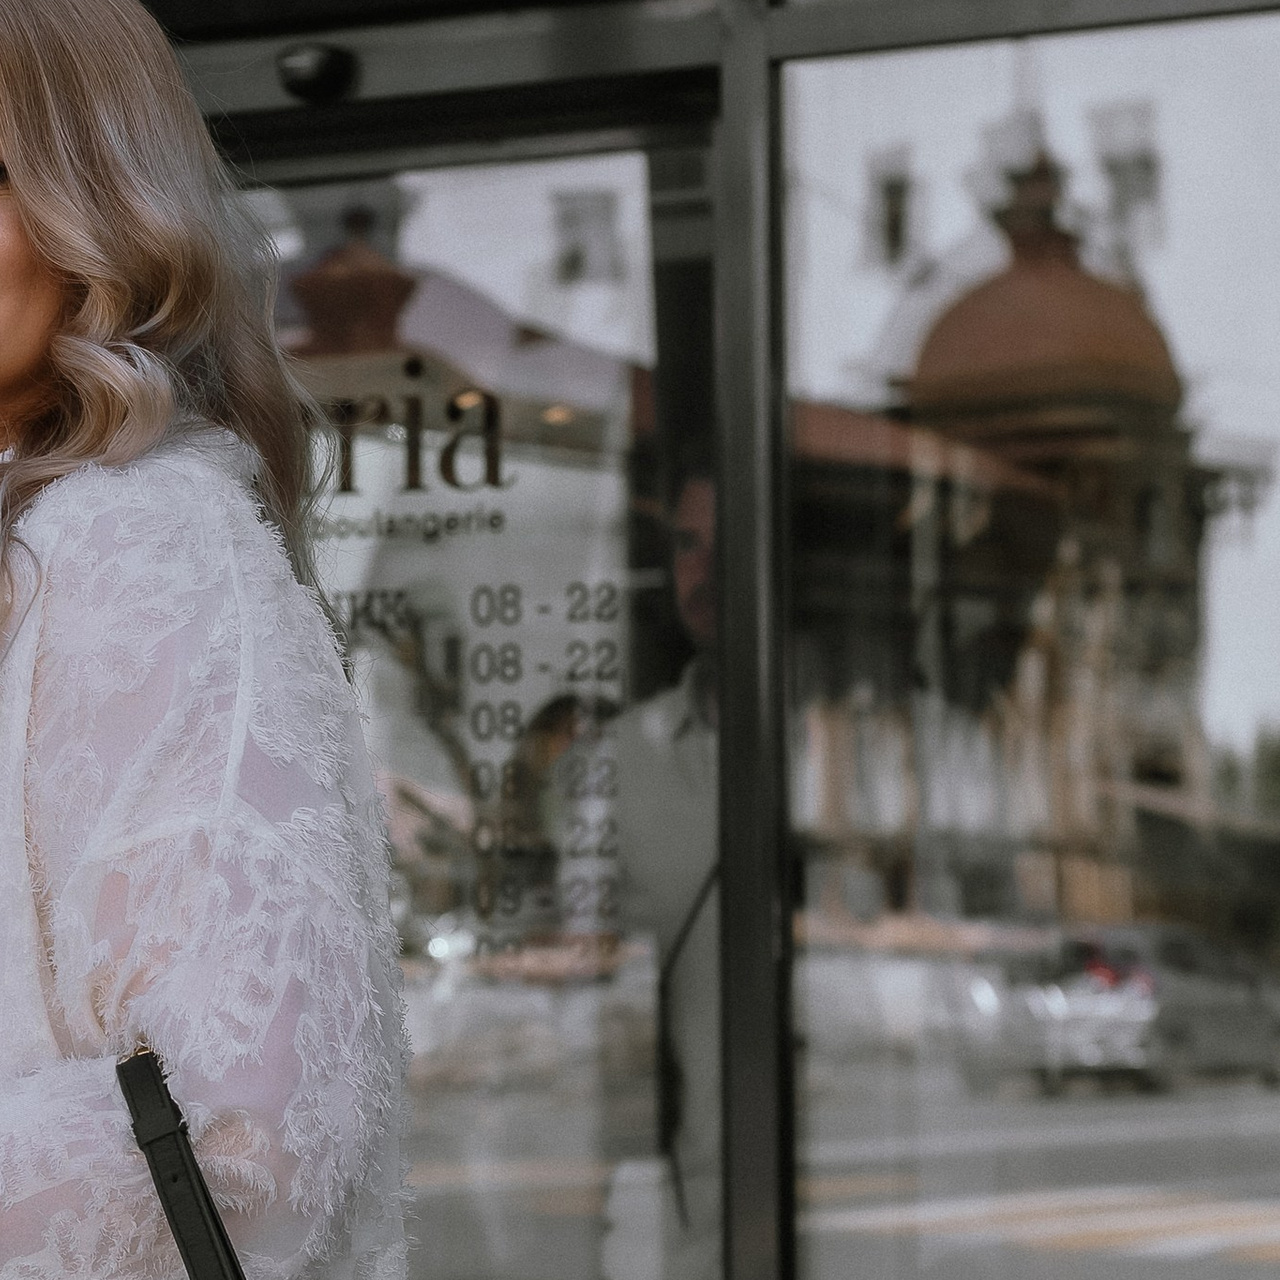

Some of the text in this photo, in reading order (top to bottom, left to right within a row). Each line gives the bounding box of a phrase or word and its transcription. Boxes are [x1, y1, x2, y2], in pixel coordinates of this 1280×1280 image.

[471, 584, 521, 627] 08
[565, 580, 619, 623] 22
[471, 642, 521, 686] 08
[565, 639, 619, 683] 22
[471, 701, 521, 742] 08
